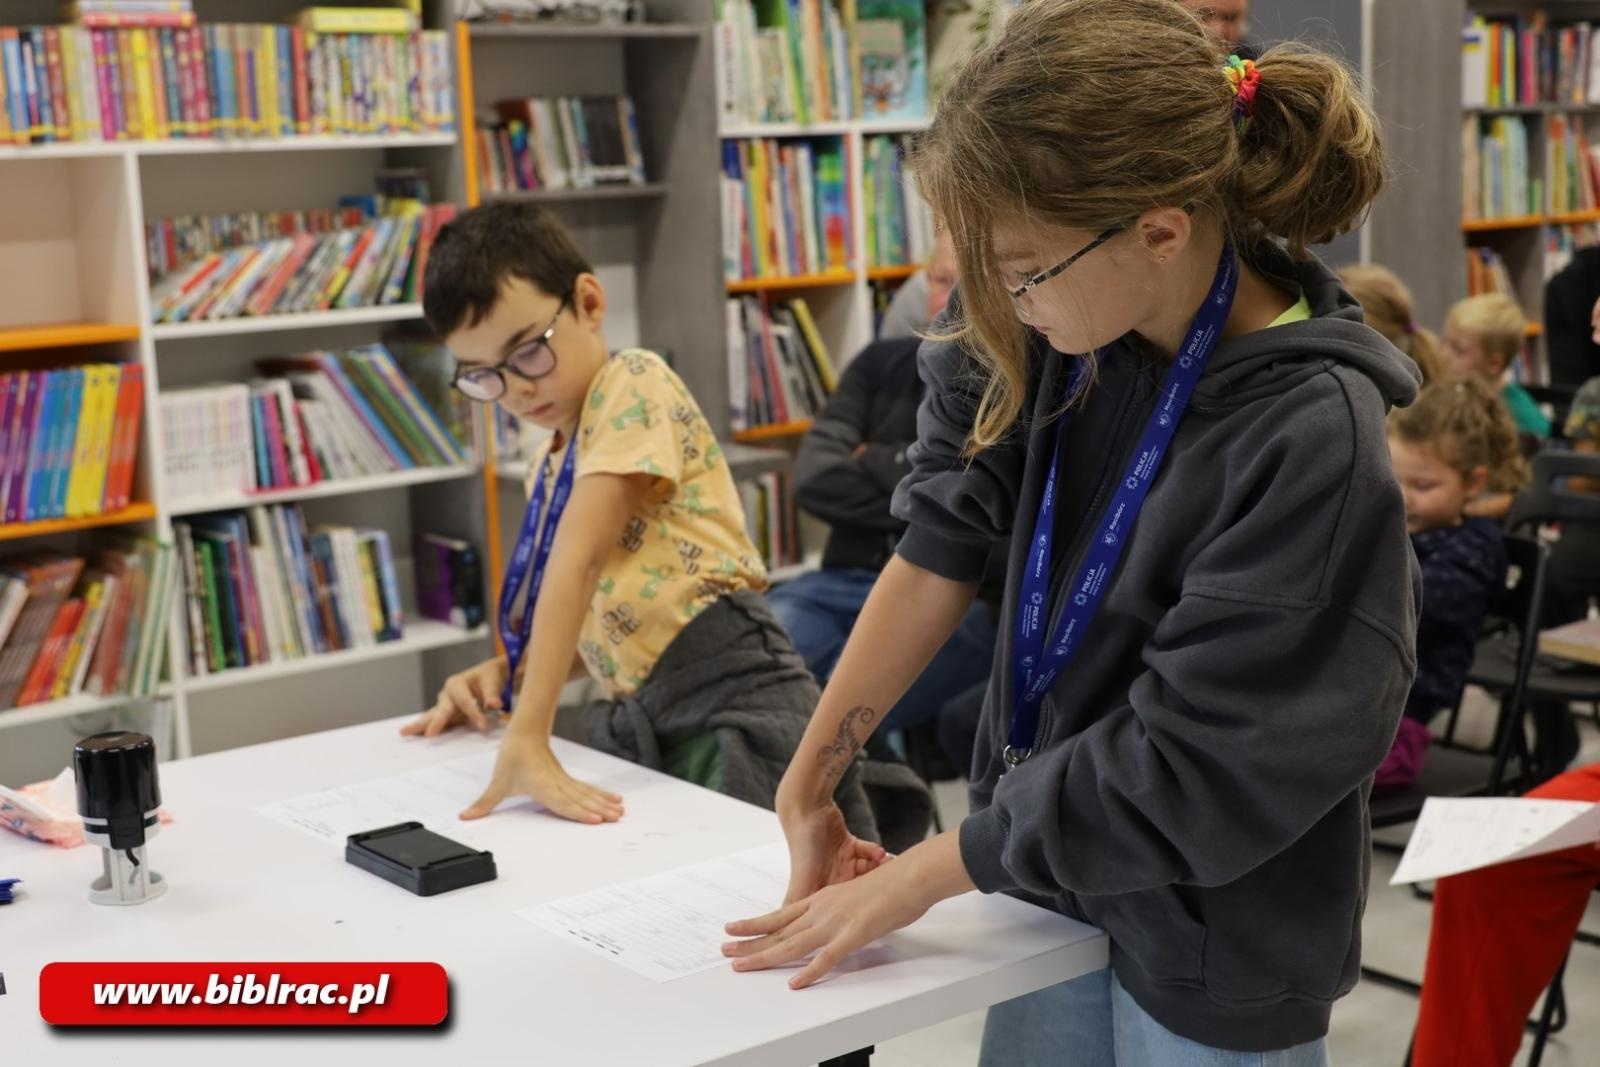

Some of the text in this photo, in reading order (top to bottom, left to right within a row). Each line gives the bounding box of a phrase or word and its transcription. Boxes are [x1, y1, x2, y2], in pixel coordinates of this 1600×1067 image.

[1187, 329, 1204, 355] POLICJA
[1134, 451, 1149, 477] POLICJA
[1109, 502, 1126, 530] Racibórz
[1082, 568, 1096, 593] POLICJA
